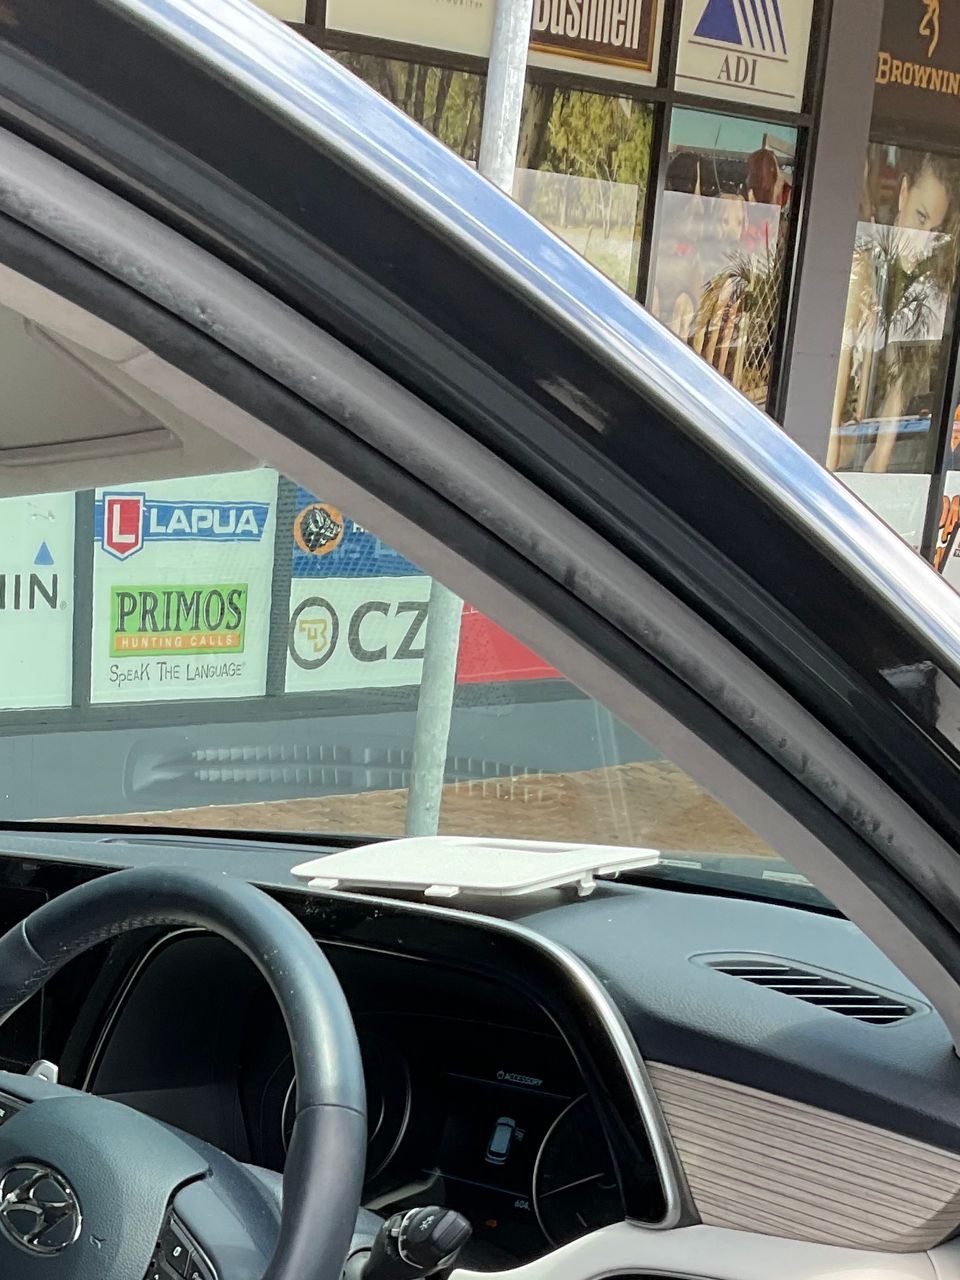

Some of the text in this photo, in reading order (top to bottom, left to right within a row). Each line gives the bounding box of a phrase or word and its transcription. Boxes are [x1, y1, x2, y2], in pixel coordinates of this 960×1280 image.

[718, 55, 758, 87] ADI
[875, 51, 960, 95] BROWNIN
[149, 508, 259, 535] LAPUA
[115, 589, 243, 632] PRIMOS
[121, 633, 233, 648] HUNTING CALLS
[348, 600, 430, 662] CZ
[157, 662, 181, 682] THE
[186, 662, 242, 681] LANGUAGE
